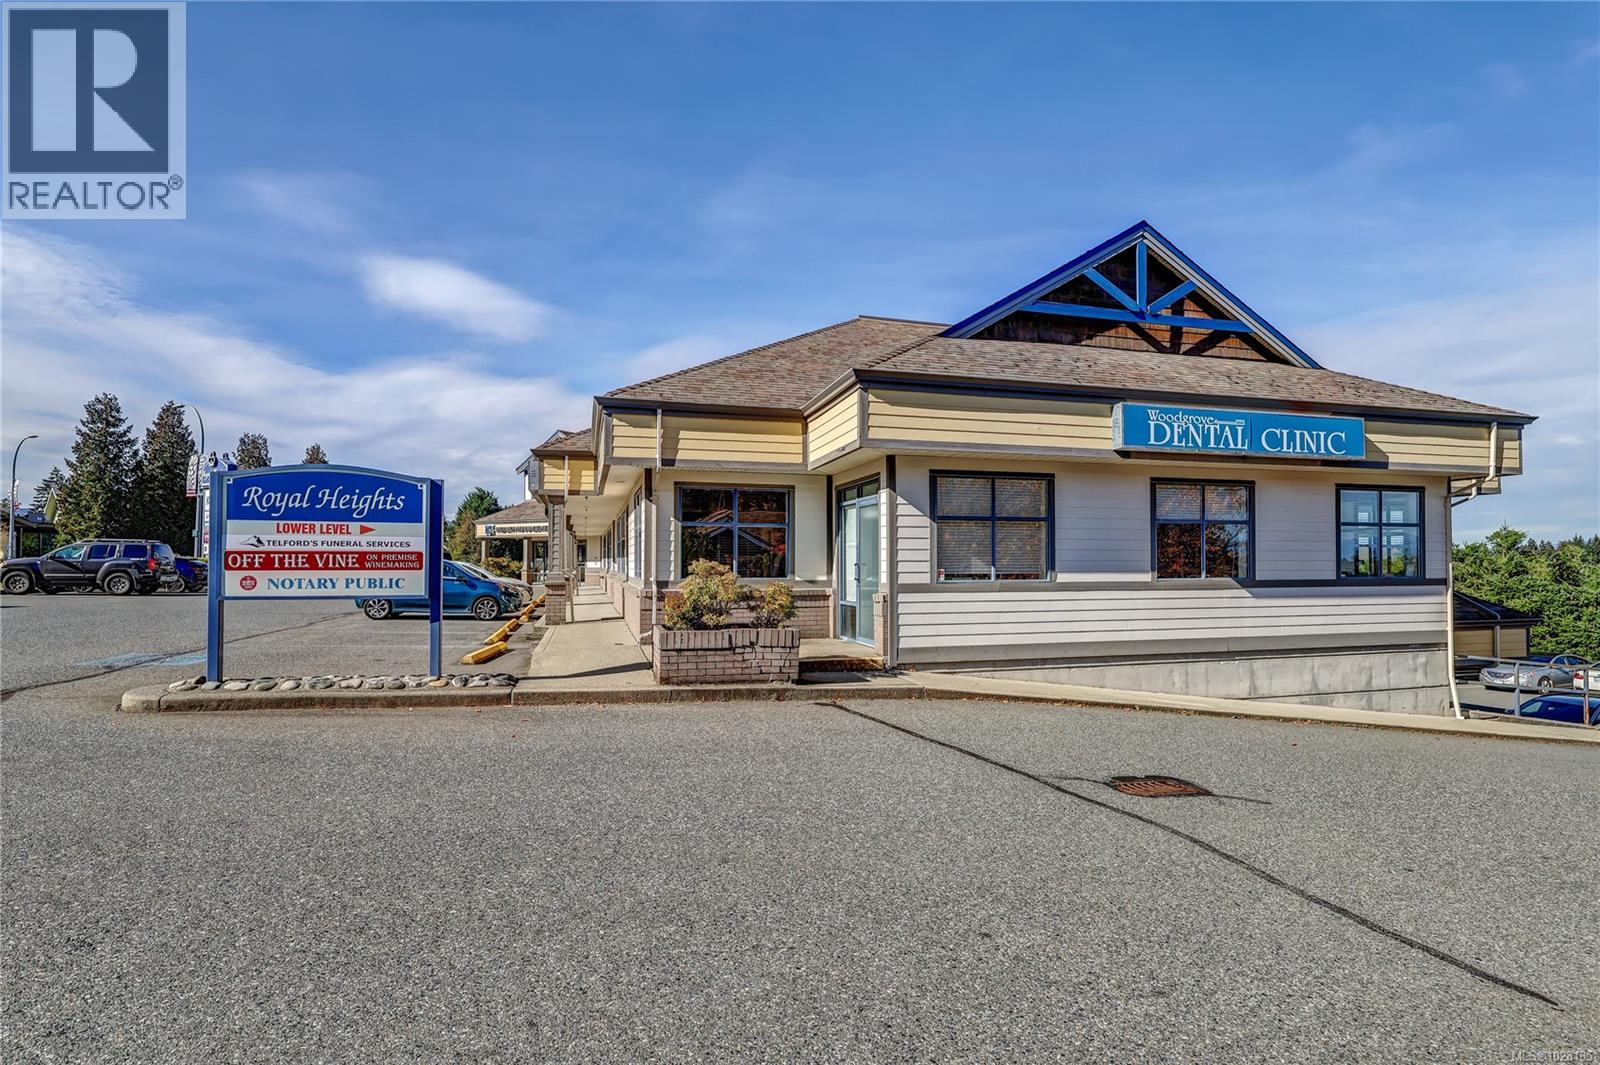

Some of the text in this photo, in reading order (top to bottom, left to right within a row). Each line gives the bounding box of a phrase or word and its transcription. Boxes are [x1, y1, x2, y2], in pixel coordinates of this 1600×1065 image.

[1147, 409, 1215, 427] Woodgrove
[1147, 420, 1346, 455] DENTAL CLINIC
[242, 484, 406, 518] Royal Heights
[276, 522, 352, 535] LOWER LEVEL
[266, 539, 411, 548] TELFORD'S FUNERAL SERVICES
[227, 553, 360, 568] OFF THE VINE
[267, 578, 339, 590] NOTARY
[344, 577, 406, 589] PUBLIC
